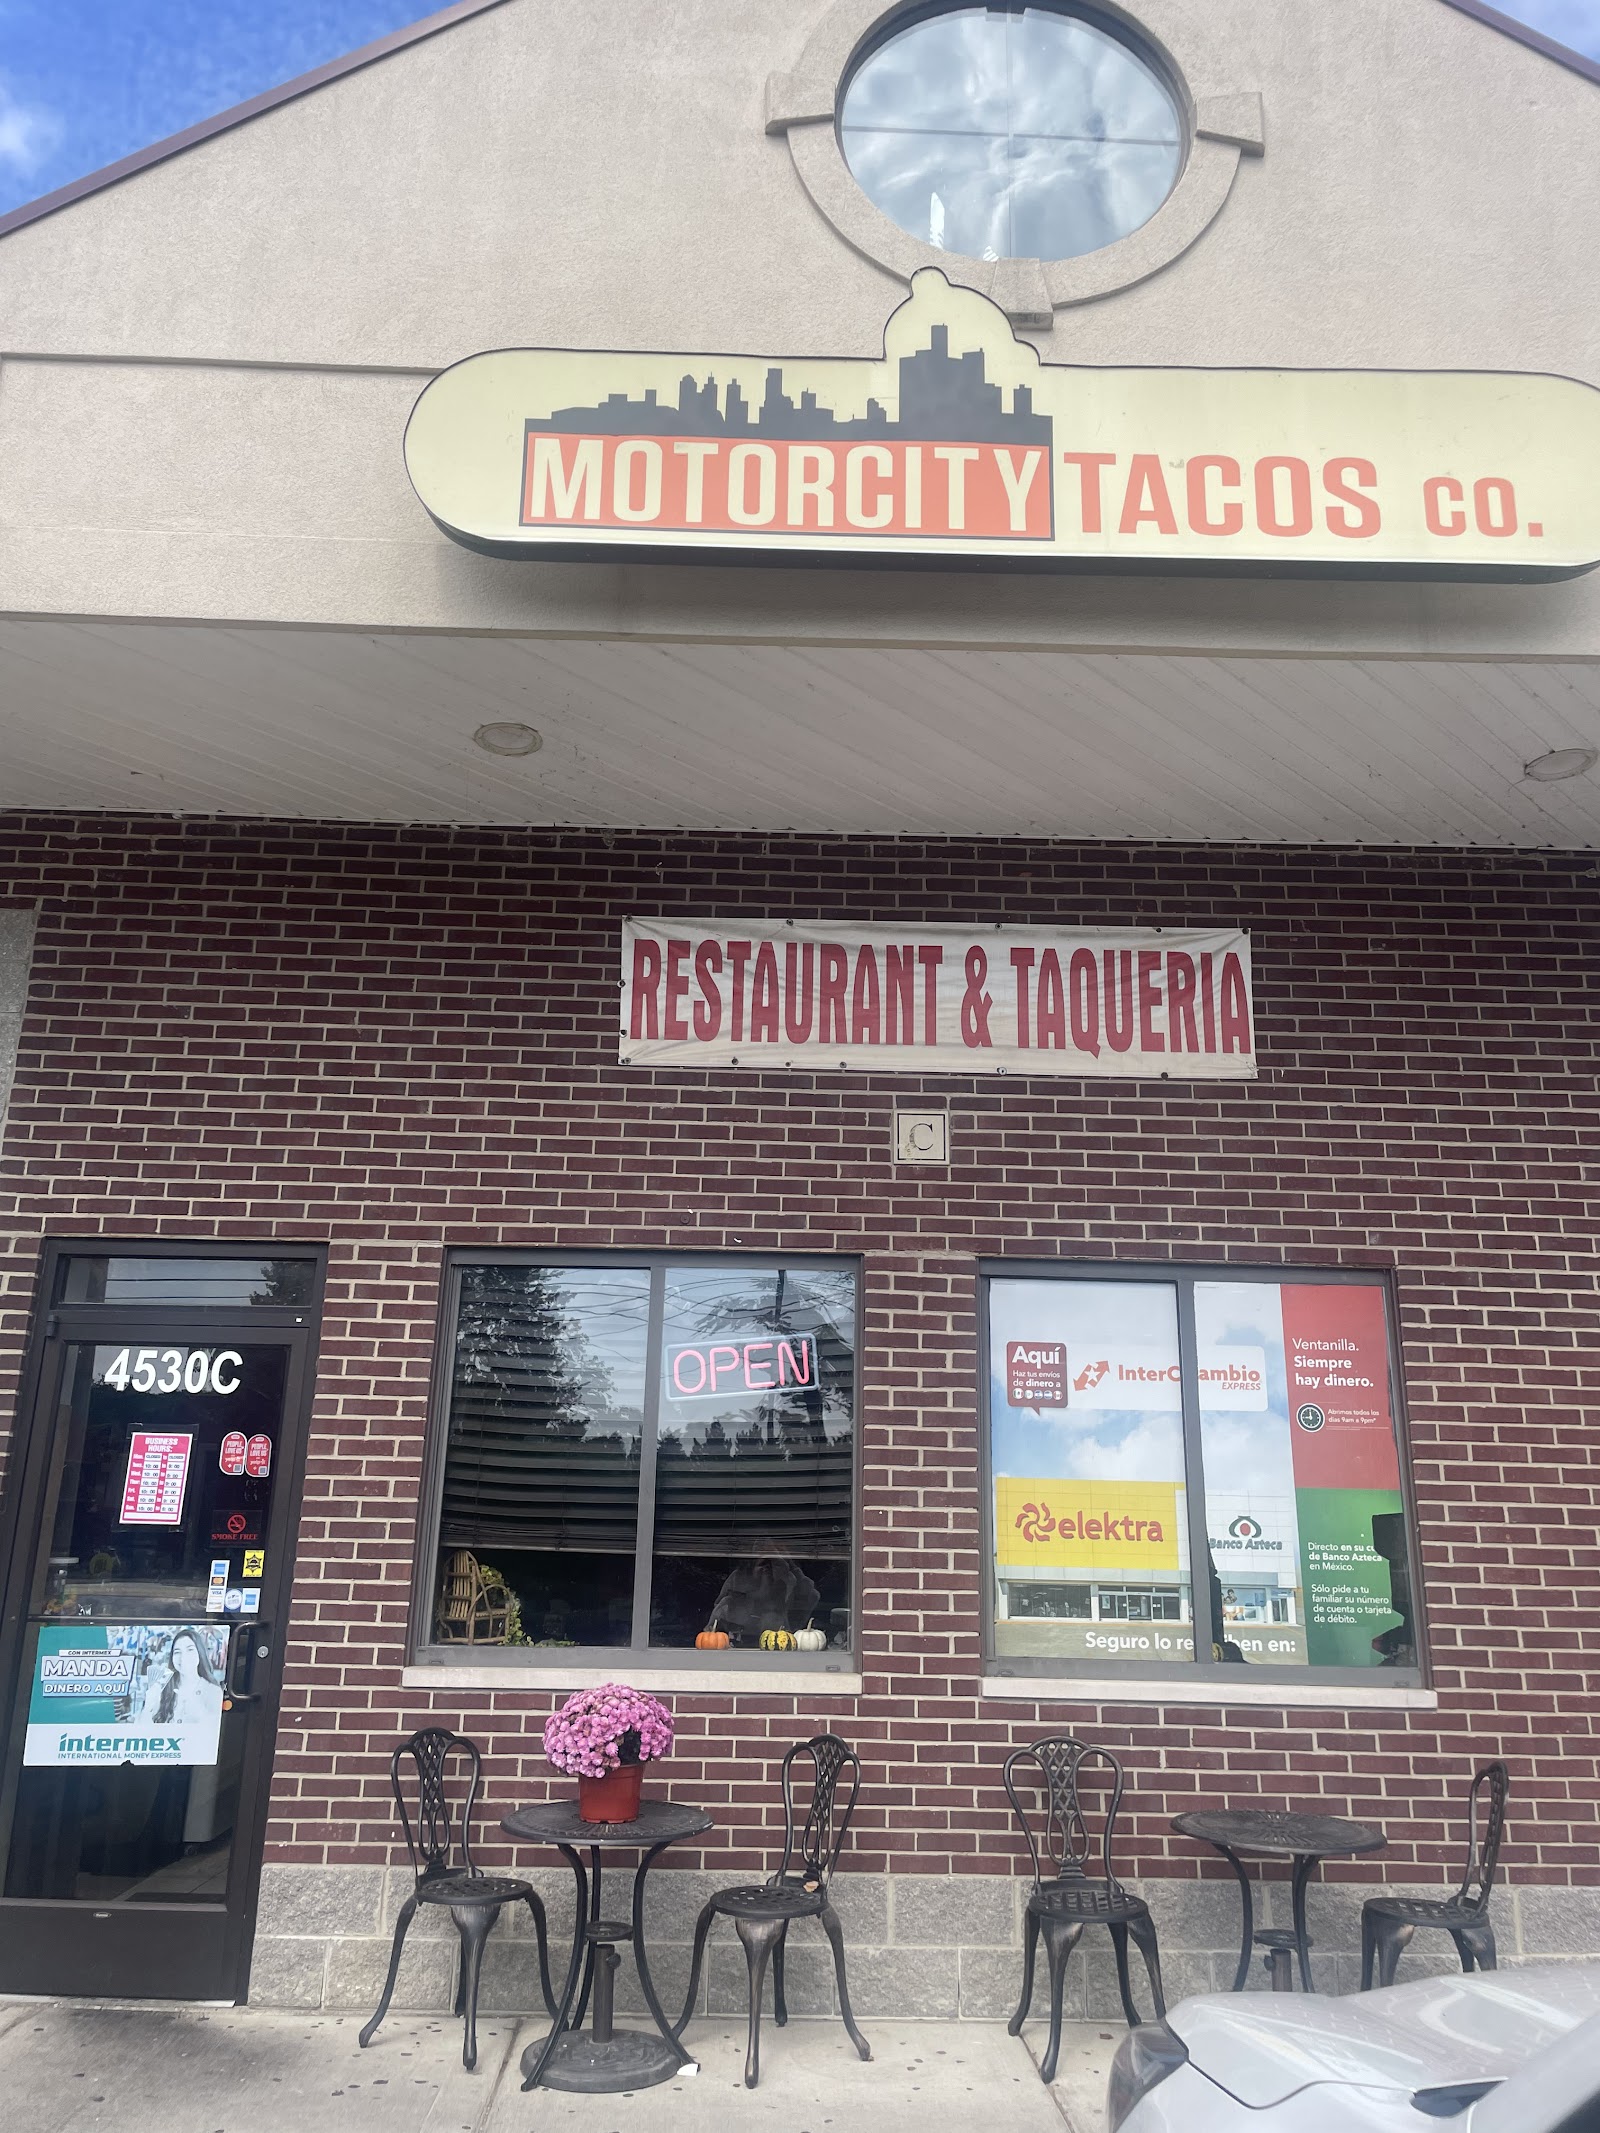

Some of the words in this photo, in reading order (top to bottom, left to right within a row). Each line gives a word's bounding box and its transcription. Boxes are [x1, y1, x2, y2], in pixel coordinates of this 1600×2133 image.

[1063, 452, 1381, 538] TACOS
[1422, 476, 1544, 537] CO.
[630, 938, 943, 1047] RESTAURANT
[960, 945, 994, 1049] &
[1010, 946, 1252, 1060] TAQUERIA
[909, 1123, 934, 1151] C
[1292, 1338, 1360, 1352] Ventanilla.
[1012, 1345, 1061, 1369] Aquí
[1294, 1355, 1352, 1371] Siempre
[104, 1349, 244, 1395] 4530C
[673, 1340, 810, 1394] OPEN
[1013, 1370, 1026, 1378] Haz
[1038, 1370, 1061, 1379] envíos
[1295, 1373, 1320, 1389] hay
[1324, 1374, 1374, 1387] dinero.
[1013, 1378, 1024, 1387] de
[1025, 1378, 1054, 1388] dinero
[1222, 1382, 1261, 1391] EXPRESS
[145, 1437, 178, 1445] BUSINESS
[148, 1445, 173, 1453] HOURS:
[1058, 1510, 1164, 1542] elektra
[1209, 1538, 1243, 1550] Banco
[1245, 1538, 1283, 1550] Azteca
[1308, 1542, 1339, 1551] Directo
[1309, 1552, 1320, 1560] de
[1322, 1552, 1350, 1561] Banco
[1352, 1553, 1383, 1562] Azteca
[1322, 1561, 1355, 1571] México.
[1311, 1584, 1330, 1593] Sólo
[1332, 1584, 1351, 1595] pide
[1360, 1586, 1369, 1594] tu
[1312, 1593, 1343, 1603] familiar
[1356, 1595, 1389, 1604] número
[1313, 1604, 1324, 1612] de
[1326, 1604, 1355, 1613] cuenta
[1364, 1606, 1392, 1616] tarjeta
[1314, 1614, 1325, 1622] de
[1327, 1614, 1357, 1623] débito.
[1085, 1631, 1149, 1652] Seguro
[1155, 1632, 1171, 1650] lo
[1267, 1638, 1296, 1652] en:
[44, 1659, 128, 1677] MANDA
[44, 1682, 92, 1694] DINERO
[94, 1680, 126, 1695] AQUÍ
[58, 1733, 183, 1752] intermex
